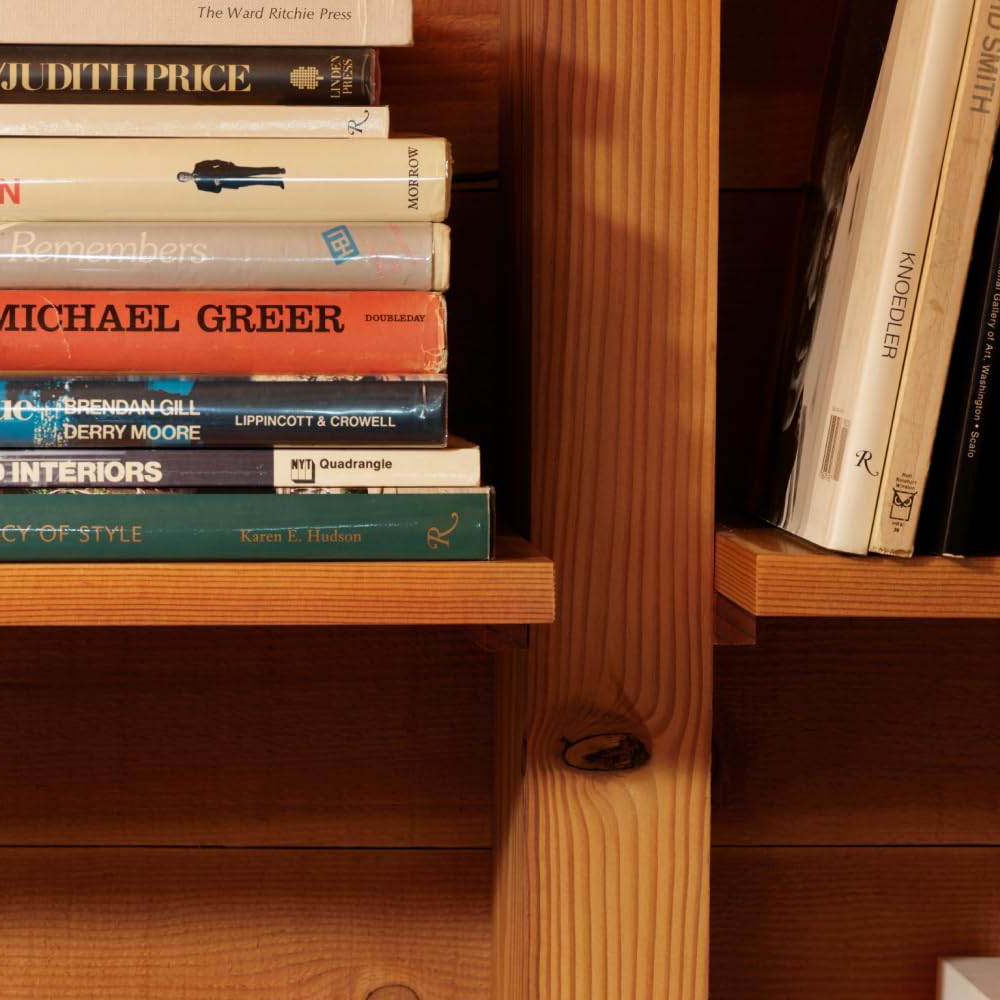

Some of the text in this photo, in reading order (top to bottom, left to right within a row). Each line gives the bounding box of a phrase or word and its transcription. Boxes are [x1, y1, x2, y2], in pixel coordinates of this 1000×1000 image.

[198, 6, 353, 21] The Ward Ritchie Press
[144, 63, 251, 92] PRICE
[330, 55, 341, 98] LINDEN
[342, 58, 353, 94] PRESS
[970, 35, 1000, 114] SMITH
[407, 147, 419, 210] MORROW
[7, 231, 207, 264] Remembers
[197, 304, 344, 333] GREER
[365, 313, 426, 323] DOUBLEDAY
[881, 251, 916, 359] KNOEDLER
[987, 293, 1000, 329] Gallery
[987, 330, 996, 340] of
[63, 399, 201, 416] BRENDAN GILL
[974, 364, 991, 422] Washington
[64, 425, 201, 440] DERRY MOORE
[235, 415, 396, 428] LIPPINCOTT & CROWELL
[967, 430, 980, 459] Scalo
[12, 461, 163, 483] INTERIORS
[291, 458, 314, 470] NYT
[319, 458, 393, 471] Quadrangle
[39, 524, 74, 543] OF
[79, 525, 143, 543] STYLE
[240, 528, 362, 543] Karen E. Hudson
